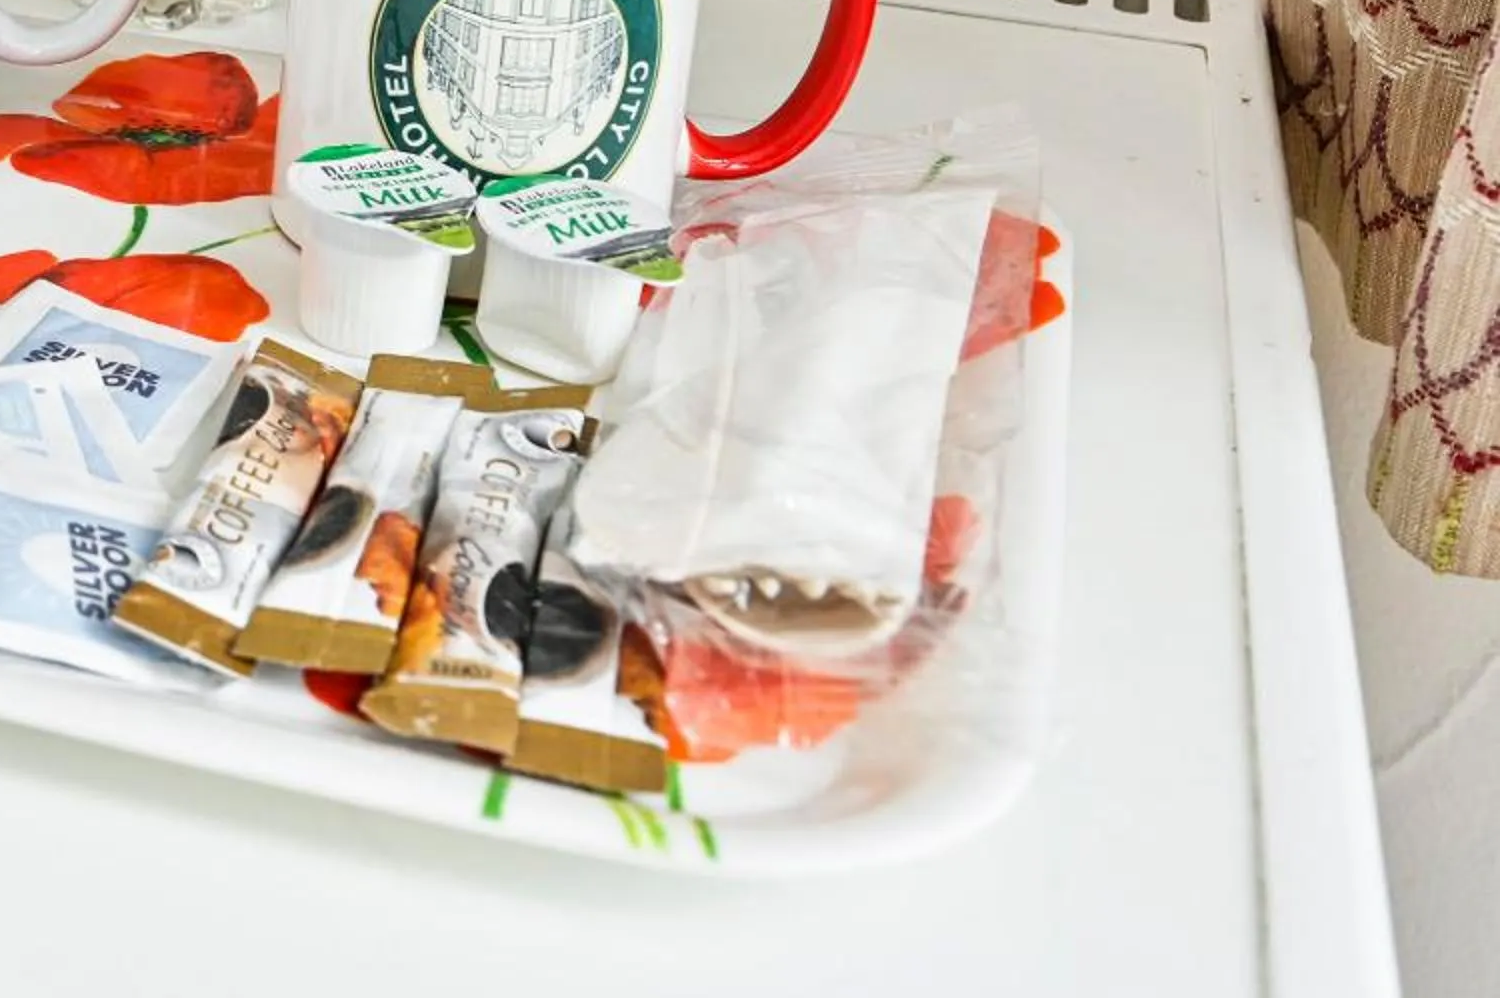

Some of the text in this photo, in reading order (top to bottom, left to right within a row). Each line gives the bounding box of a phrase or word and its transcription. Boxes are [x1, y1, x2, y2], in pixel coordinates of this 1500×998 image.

[611, 60, 650, 144] CITY
[358, 185, 446, 209] Milk
[545, 210, 629, 245] Milk
[207, 448, 279, 545] COFFEE
[465, 457, 522, 537] COFFEE
[68, 522, 106, 621] SILVER
